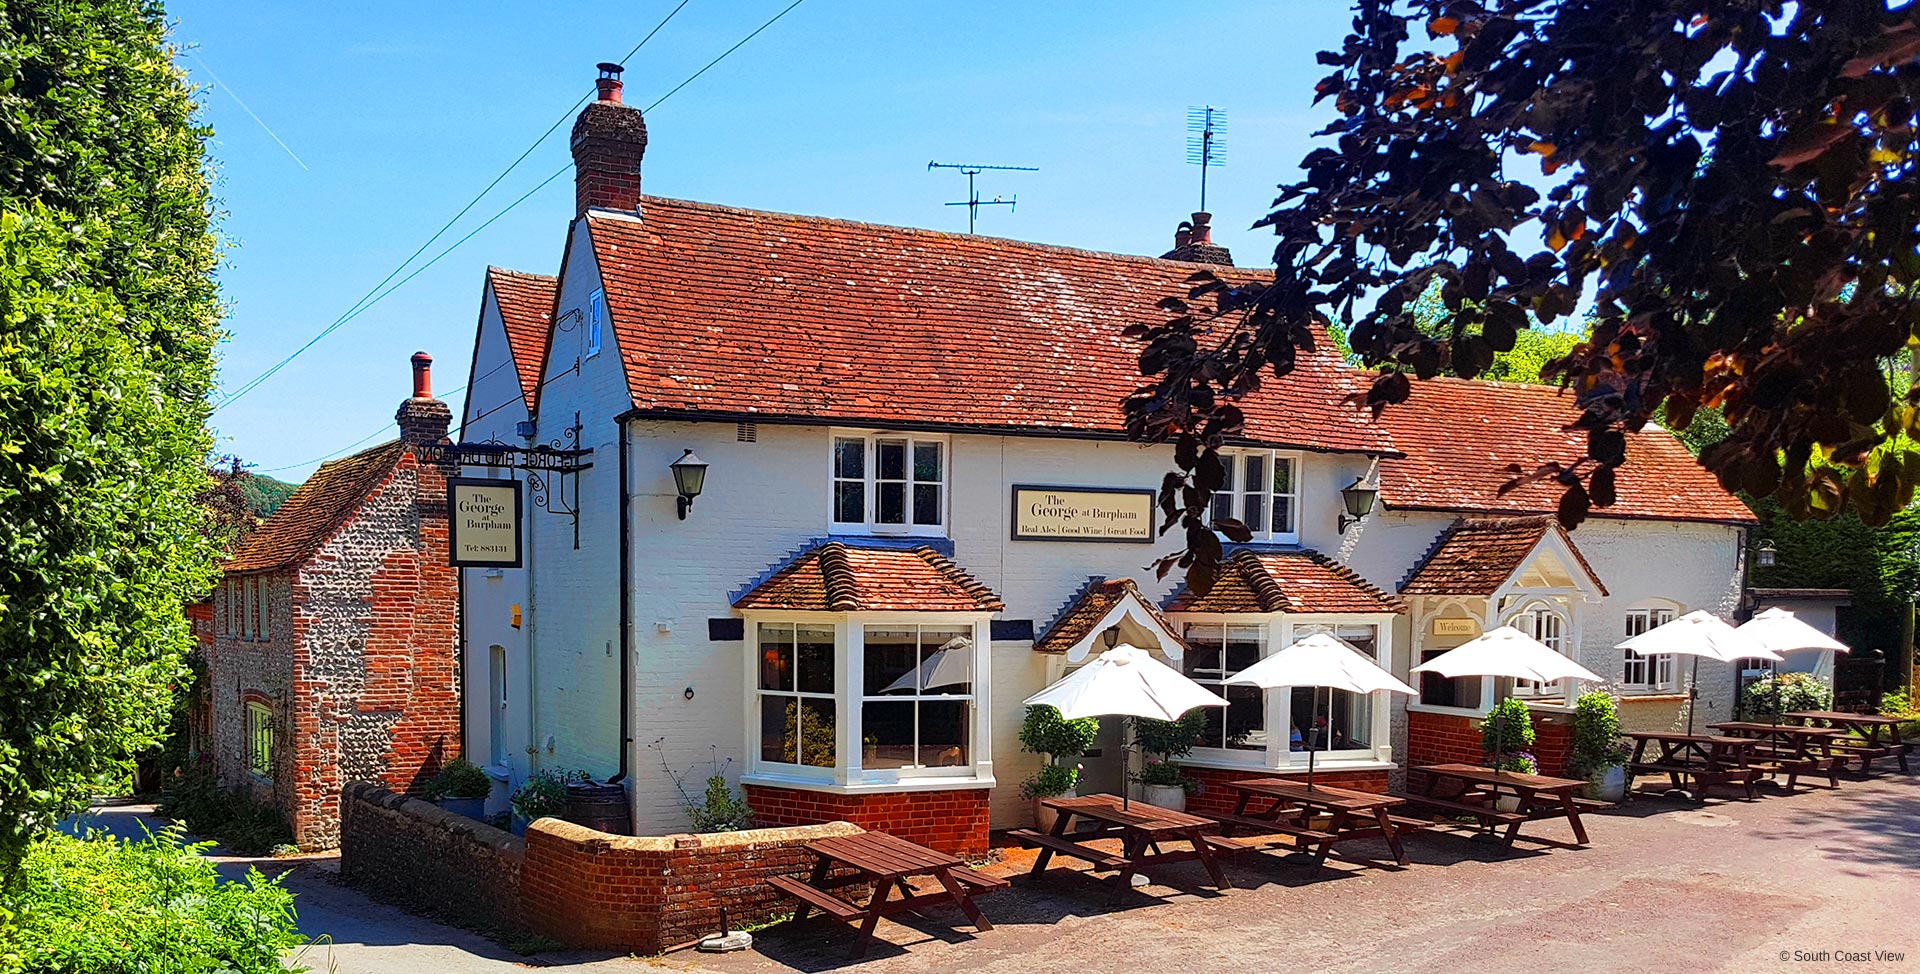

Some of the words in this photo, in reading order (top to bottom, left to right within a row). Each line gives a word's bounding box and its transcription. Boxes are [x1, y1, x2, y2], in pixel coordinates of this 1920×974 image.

[472, 493, 492, 503] The
[1045, 495, 1065, 506] The
[459, 500, 505, 517] George
[1031, 503, 1078, 520] George
[1081, 509, 1090, 517] at
[1092, 508, 1137, 521] Burpham
[466, 519, 512, 531] Burpham
[1021, 525, 1038, 533] Real
[1040, 525, 1056, 534] Ales
[1061, 526, 1081, 535] Good
[1083, 526, 1102, 535] Wine
[1107, 527, 1127, 536] Great
[1129, 527, 1146, 536] Food
[464, 544, 479, 552] Tel:
[480, 544, 507, 553] 883131
[1440, 622, 1472, 631] Welcome
